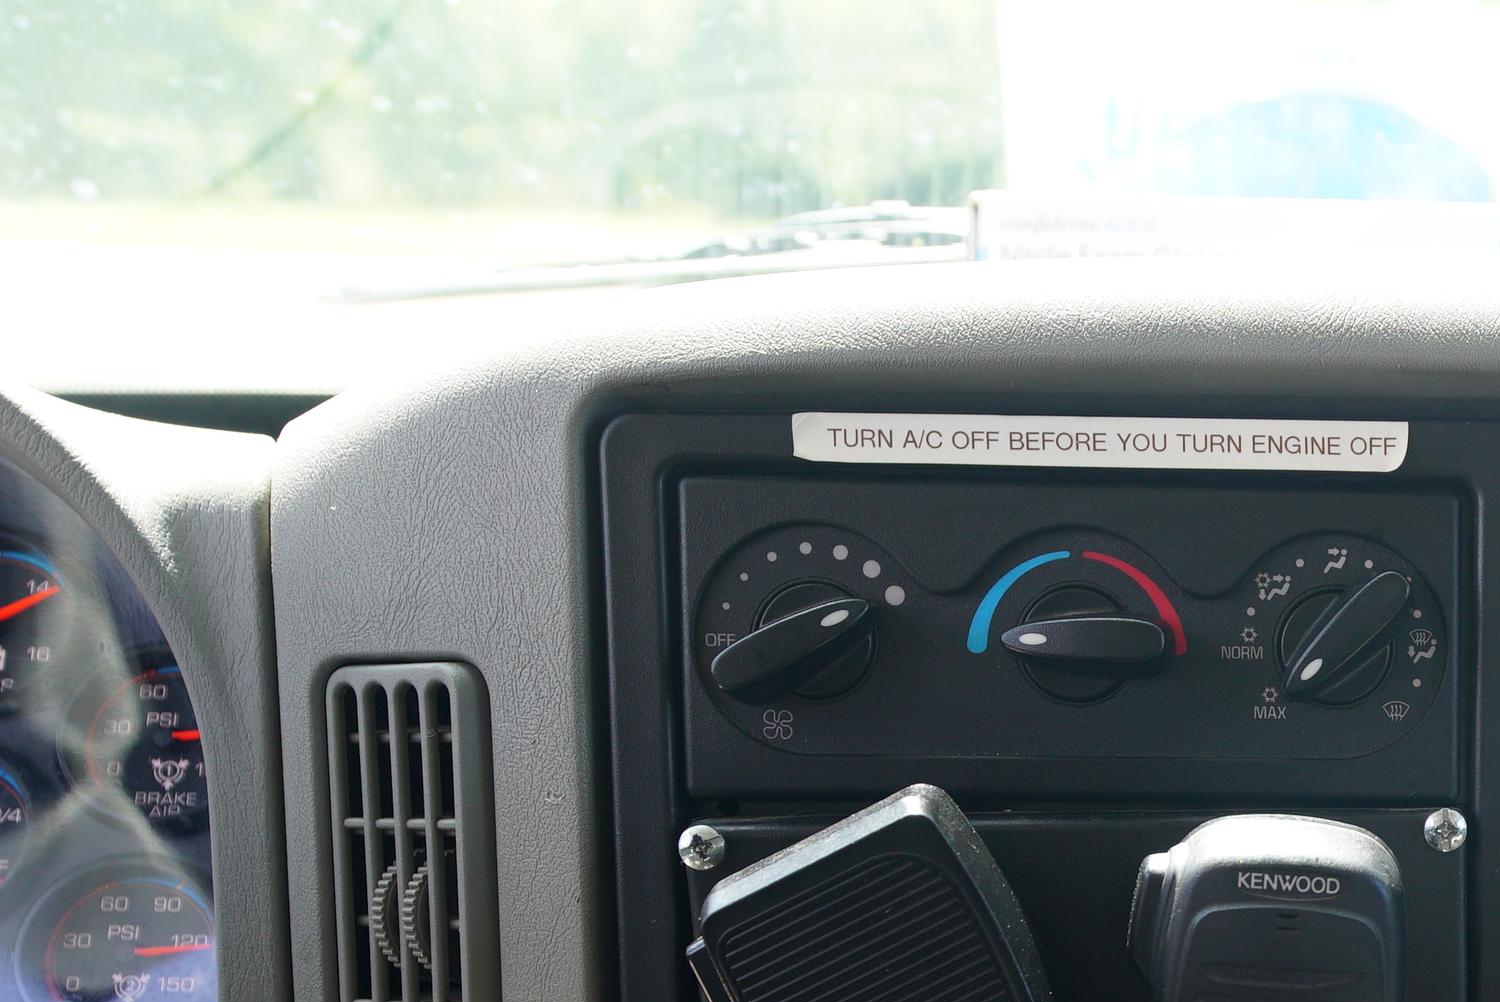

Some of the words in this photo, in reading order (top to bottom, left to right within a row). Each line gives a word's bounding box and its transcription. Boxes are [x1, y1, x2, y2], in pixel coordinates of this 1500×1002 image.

[826, 428, 893, 448] TURN
[902, 429, 943, 449] A/C
[951, 430, 999, 450] OFF
[1008, 431, 1107, 452] BEFORE
[1117, 433, 1167, 452] YOU
[1176, 434, 1242, 454] TURN
[1252, 435, 1341, 455] ENGINE
[1350, 437, 1397, 456] OFF
[27, 579, 49, 594] 14
[705, 632, 736, 647] OFF
[1220, 645, 1264, 660] NORM
[139, 684, 168, 699] 60
[145, 711, 179, 727] PSI
[1253, 705, 1287, 720] MAX
[104, 720, 131, 735] 30
[106, 761, 120, 776] 0
[134, 791, 197, 806] BRAKE
[0, 807, 22, 823] /4
[1237, 872, 1340, 894] KENWOOD
[100, 896, 128, 911] 60
[153, 896, 182, 912] 90
[107, 924, 140, 940] PSI
[63, 933, 91, 948] 30
[171, 934, 209, 948] 120
[65, 976, 80, 991] 0
[158, 976, 196, 992] 150
